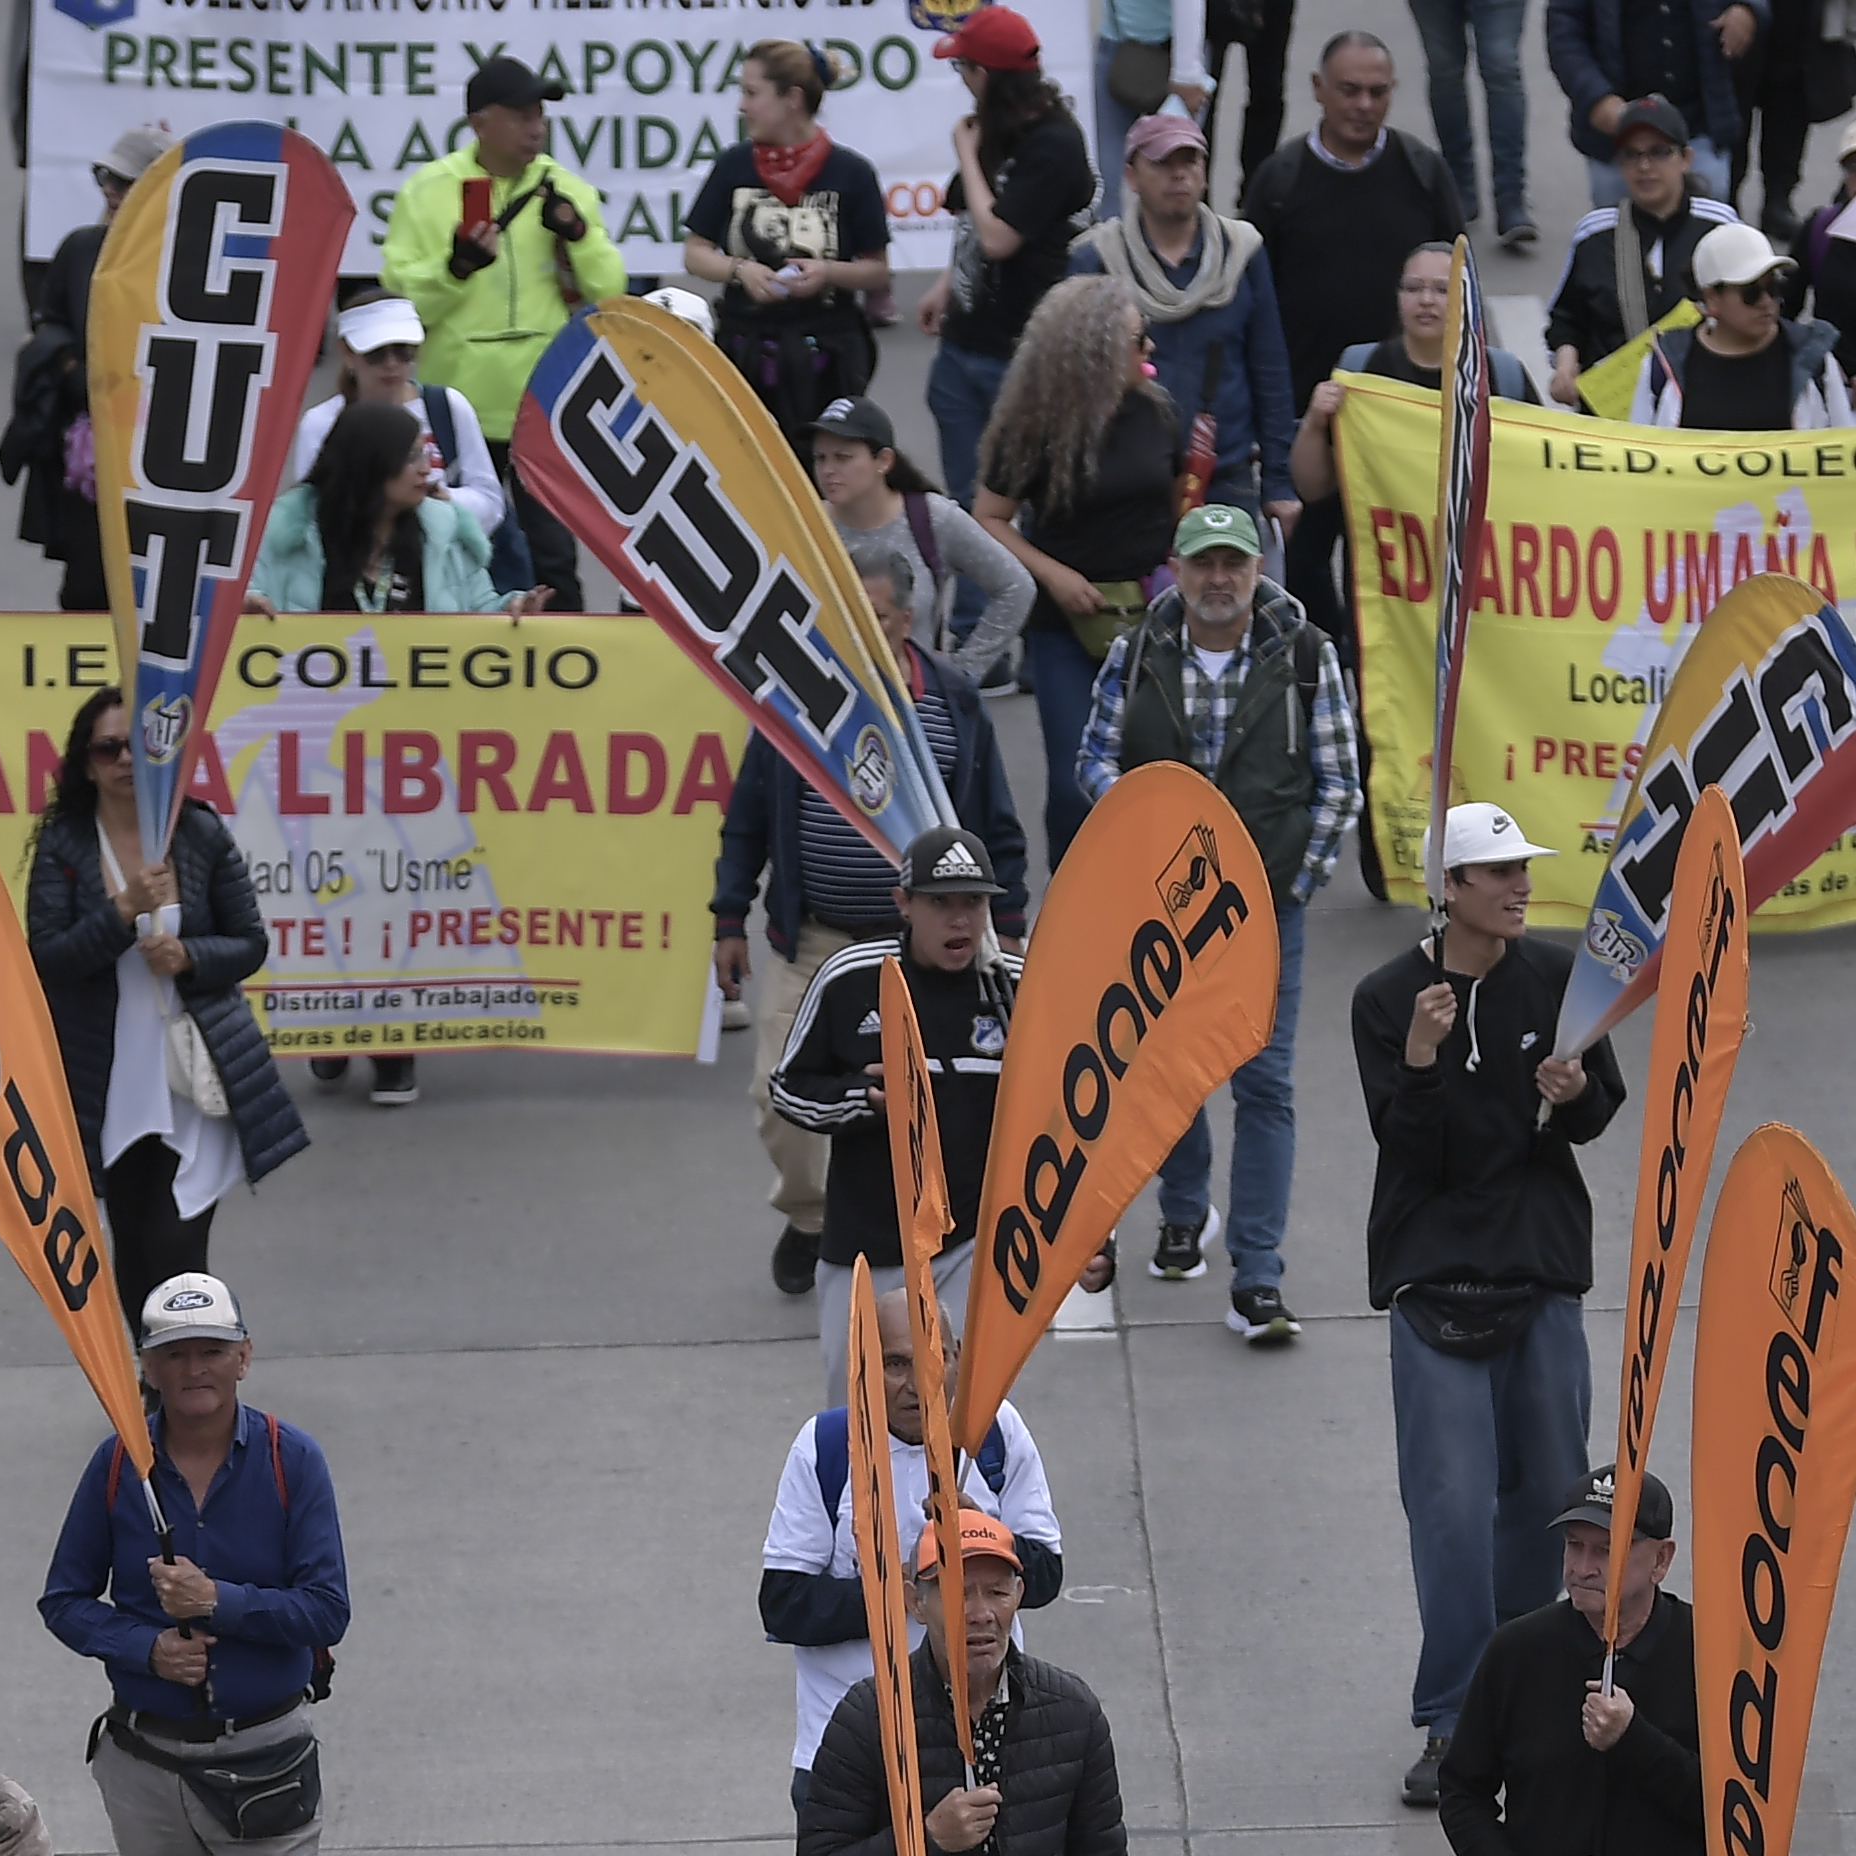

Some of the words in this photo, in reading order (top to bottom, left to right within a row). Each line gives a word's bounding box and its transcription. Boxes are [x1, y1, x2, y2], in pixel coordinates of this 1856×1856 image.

[105, 33, 436, 96] PRESENTE
[540, 34, 918, 95] APOYADO
[394, 114, 748, 171] ACIVIDA
[127, 170, 276, 659] CUT
[1542, 437, 1674, 475] I.E.D.
[560, 352, 848, 735] CUT
[1371, 506, 1622, 622] EDARDO
[24, 645, 108, 688] I.E.
[238, 645, 600, 689] COLEGIO
[1568, 662, 1666, 704] Locali
[277, 730, 735, 815] LIBRADA
[1534, 735, 1646, 781] PRES
[1621, 626, 1853, 926] CUT
[305, 848, 345, 894] 05
[931, 864, 984, 878] adidas
[1820, 870, 1849, 892] de
[343, 916, 353, 956] !
[408, 907, 644, 950] PRESENTE
[661, 911, 671, 950] !
[262, 990, 363, 1012] Distrital
[373, 990, 402, 1009] de
[411, 986, 579, 1011] Trabajadores
[343, 1024, 373, 1044] de
[381, 1024, 404, 1043] la
[414, 1021, 546, 1043] Educación
[992, 880, 1250, 1315] fecode
[1585, 1493, 1614, 1505] adida
[960, 1526, 998, 1541] code
